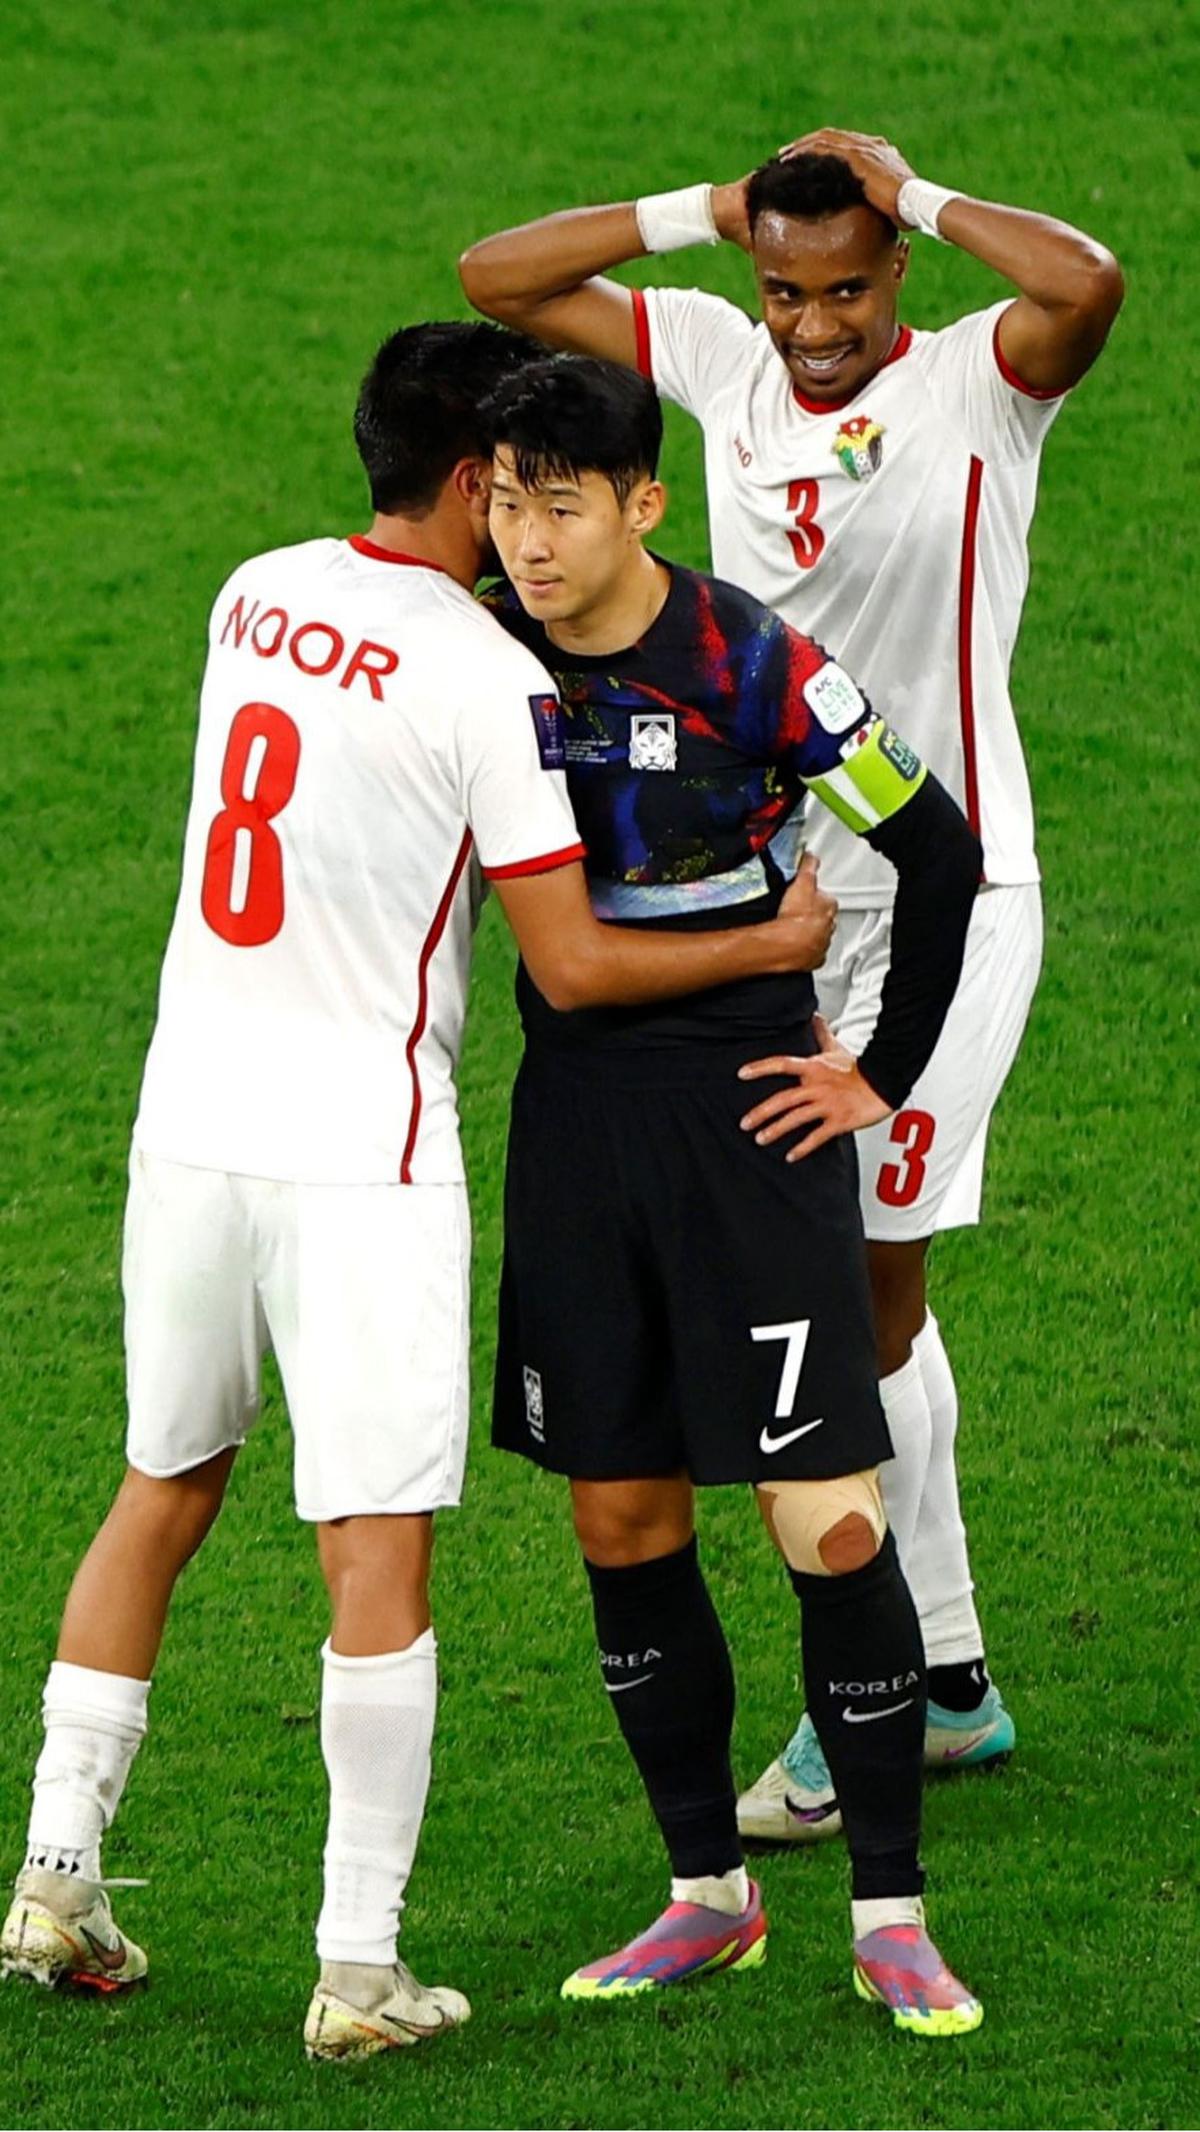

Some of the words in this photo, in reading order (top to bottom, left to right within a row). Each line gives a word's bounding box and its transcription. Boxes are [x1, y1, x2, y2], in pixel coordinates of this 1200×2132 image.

[785, 477, 825, 569] 3
[220, 595, 399, 702] NOOR
[201, 702, 300, 947] 8
[875, 1108, 936, 1207] 3
[750, 1319, 810, 1418] 7
[599, 1648, 662, 1668] OREA
[828, 1670, 919, 1695] KOREA
